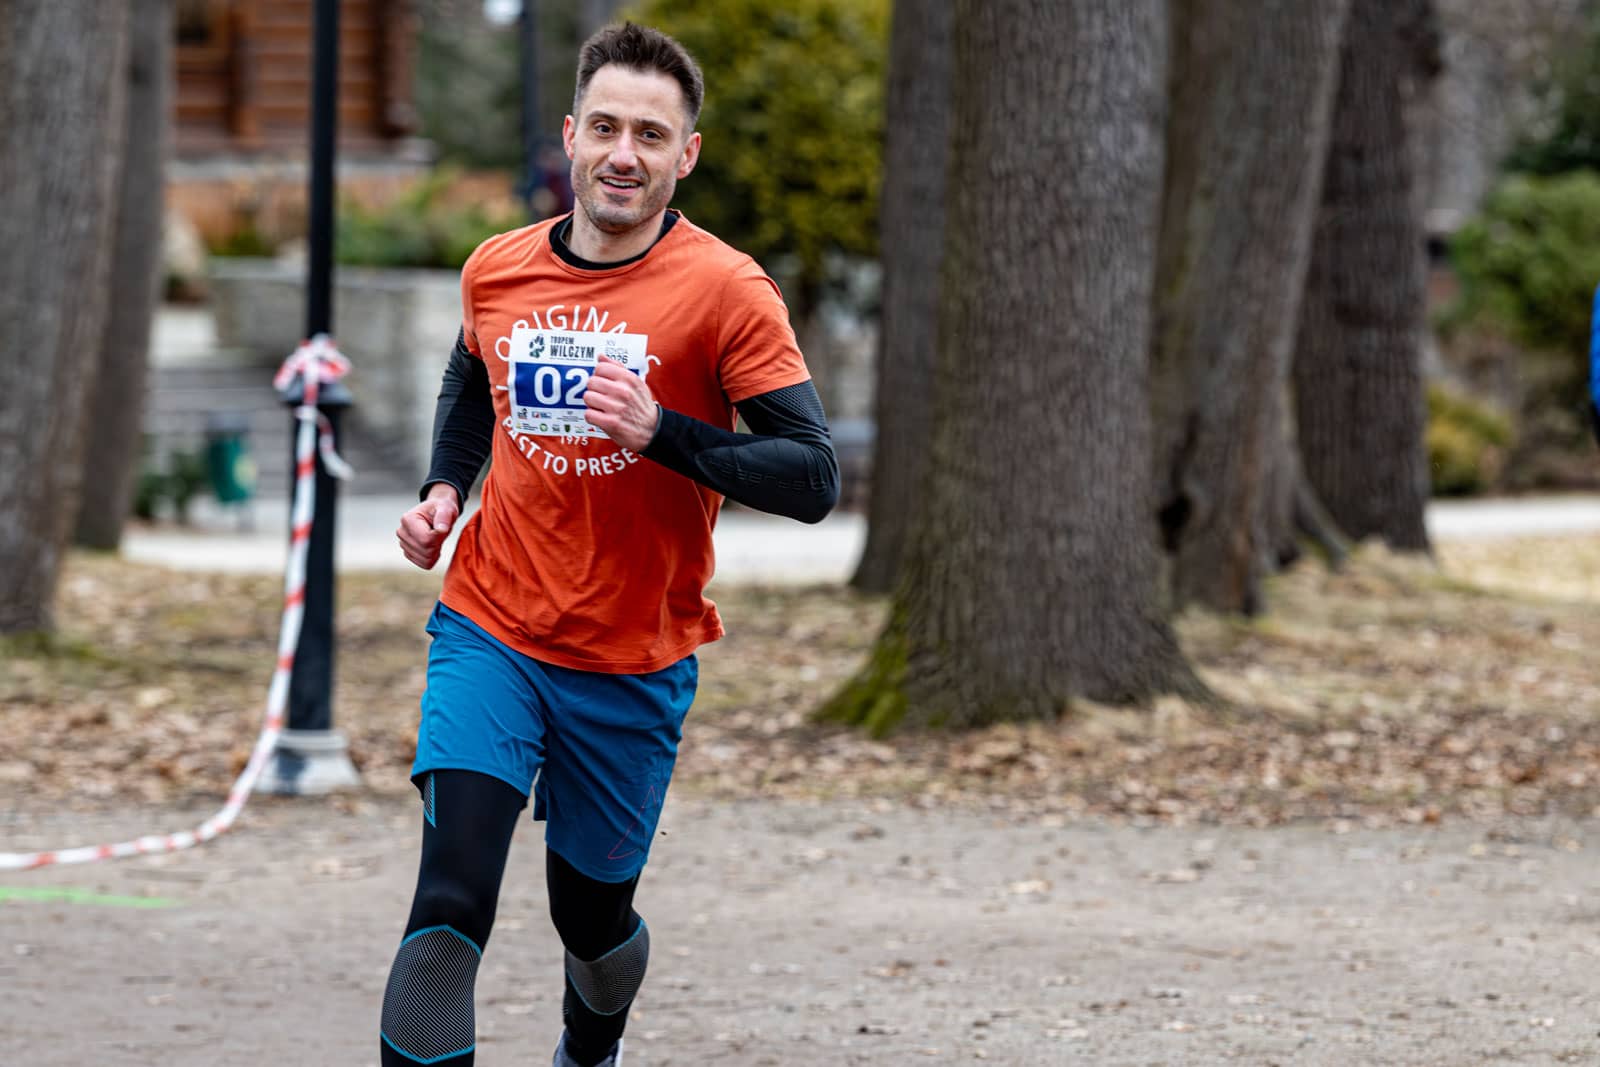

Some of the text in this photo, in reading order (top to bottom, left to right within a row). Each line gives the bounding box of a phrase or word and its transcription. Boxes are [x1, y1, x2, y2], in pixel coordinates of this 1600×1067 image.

[550, 336, 576, 345] TROPEM
[549, 345, 595, 359] WILCZYM
[534, 366, 590, 406] 02
[543, 450, 568, 475] TO
[575, 447, 644, 477] PRESE
